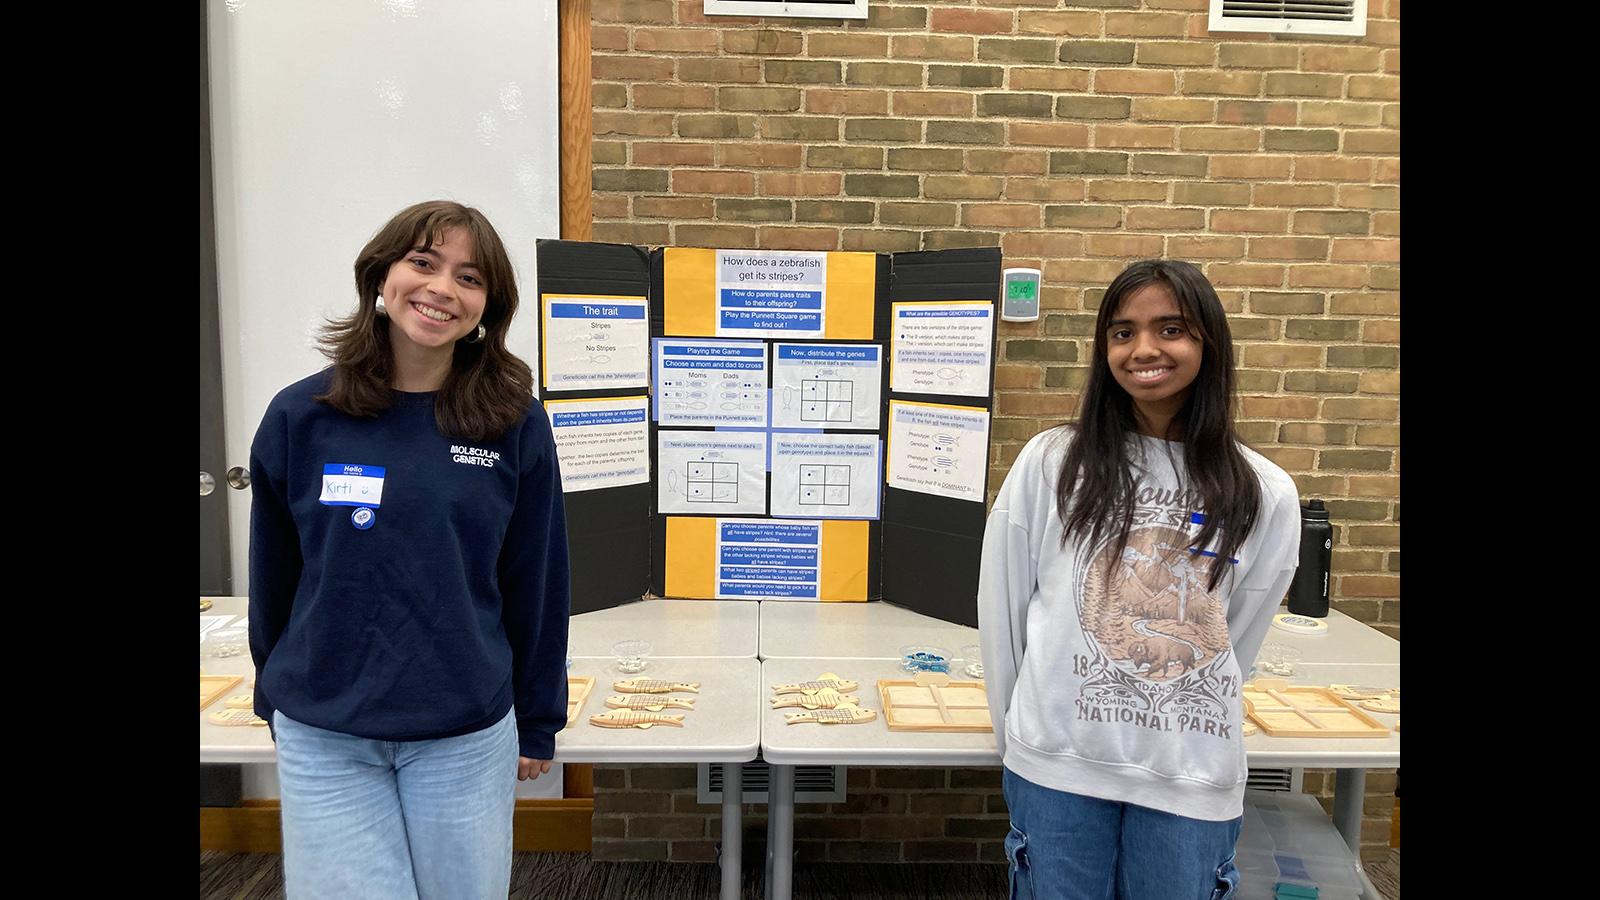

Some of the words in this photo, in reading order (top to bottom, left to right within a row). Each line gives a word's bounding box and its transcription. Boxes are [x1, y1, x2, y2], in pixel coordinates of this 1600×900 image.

[724, 257, 743, 265] How
[746, 258, 768, 266] does
[780, 259, 820, 267] zebrafish
[739, 272, 753, 281] get
[756, 272, 766, 280] its
[769, 272, 804, 281] stripes?
[583, 306, 600, 315] The
[602, 307, 618, 315] trait
[450, 445, 500, 461] MOLECULAR
[453, 455, 493, 467] GENETICS
[327, 482, 351, 494] Kirti
[1073, 654, 1088, 677] 18
[1138, 682, 1173, 693] IDAHO
[1221, 675, 1237, 698] 72
[1086, 696, 1137, 708] WYOMING
[1170, 706, 1222, 719] MONTANA
[1075, 699, 1172, 731] NATIONAL
[1178, 713, 1232, 739] PARK
